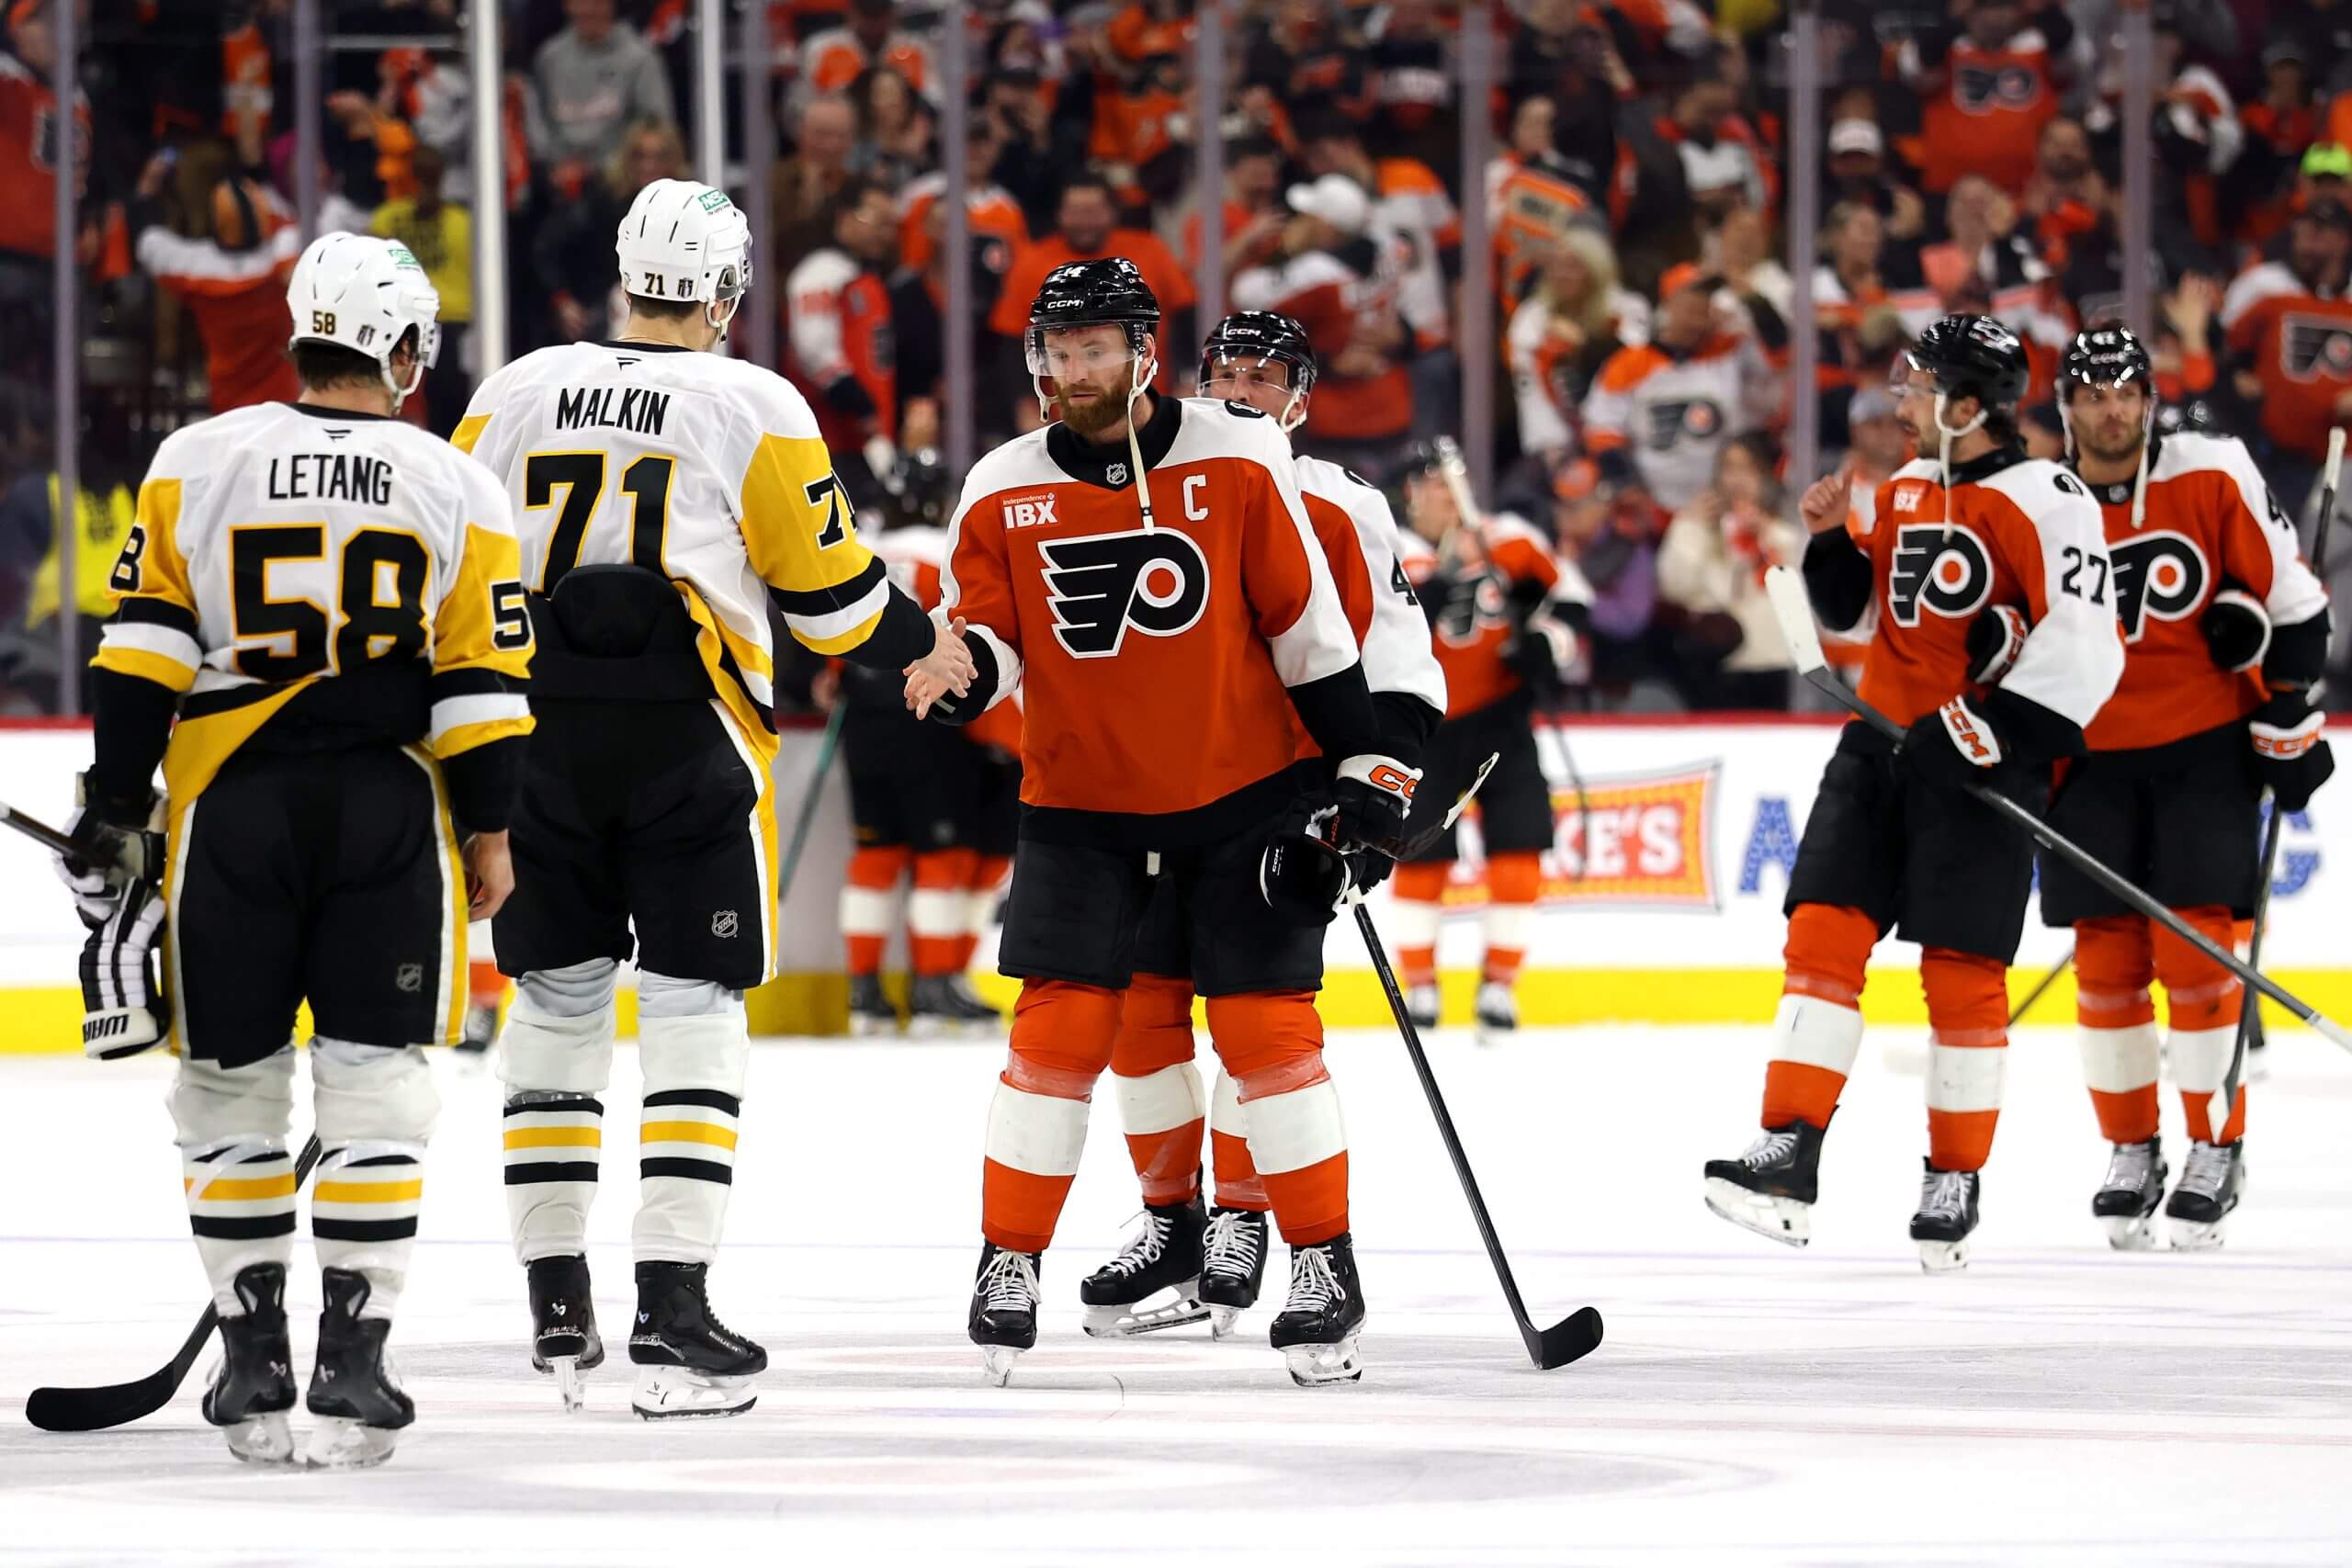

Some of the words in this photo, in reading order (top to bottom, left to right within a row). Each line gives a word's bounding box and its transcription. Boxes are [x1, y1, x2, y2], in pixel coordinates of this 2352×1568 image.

[645, 272, 665, 296] 71
[1047, 299, 1080, 310] CCM
[312, 310, 336, 335] 58
[556, 388, 672, 436] MALKIN
[268, 453, 393, 506] LETANG
[1002, 493, 1046, 505] Independence
[1182, 474, 1209, 522] C
[524, 450, 678, 598] 71
[1003, 501, 1057, 529] IBX
[2062, 546, 2108, 606] 27
[228, 523, 431, 682] 58
[490, 581, 533, 651] 5
[2253, 731, 2322, 754] CCM
